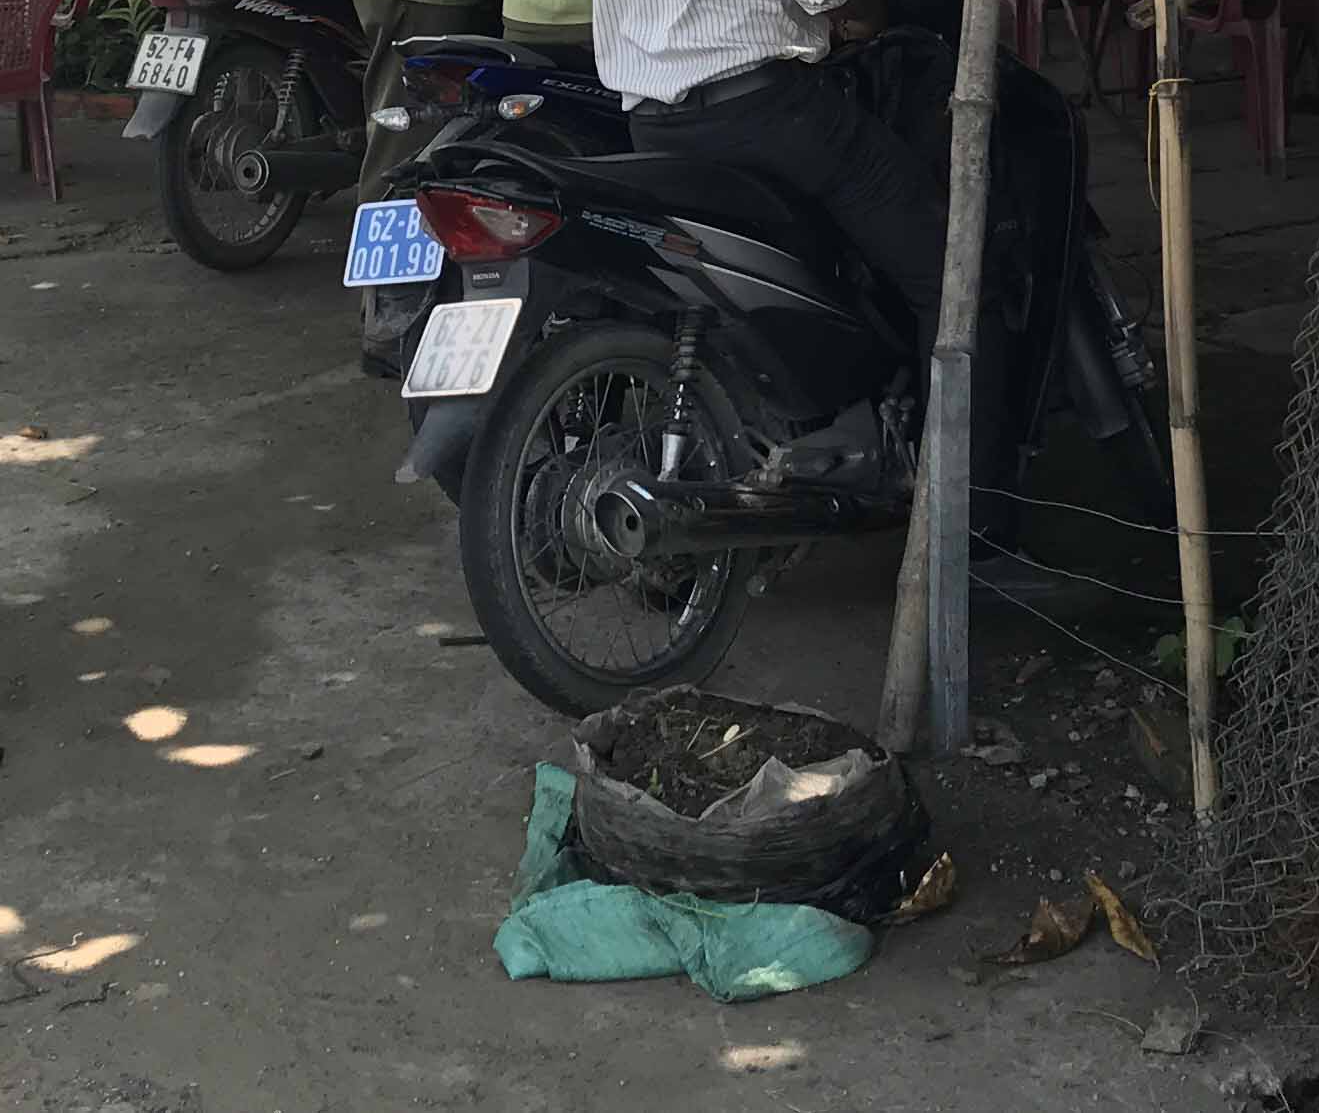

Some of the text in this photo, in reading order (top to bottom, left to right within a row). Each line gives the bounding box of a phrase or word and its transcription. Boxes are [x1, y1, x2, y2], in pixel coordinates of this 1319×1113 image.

[138, 62, 188, 88] 6840
[368, 209, 428, 242] 62-B
[352, 240, 440, 279] 001.98
